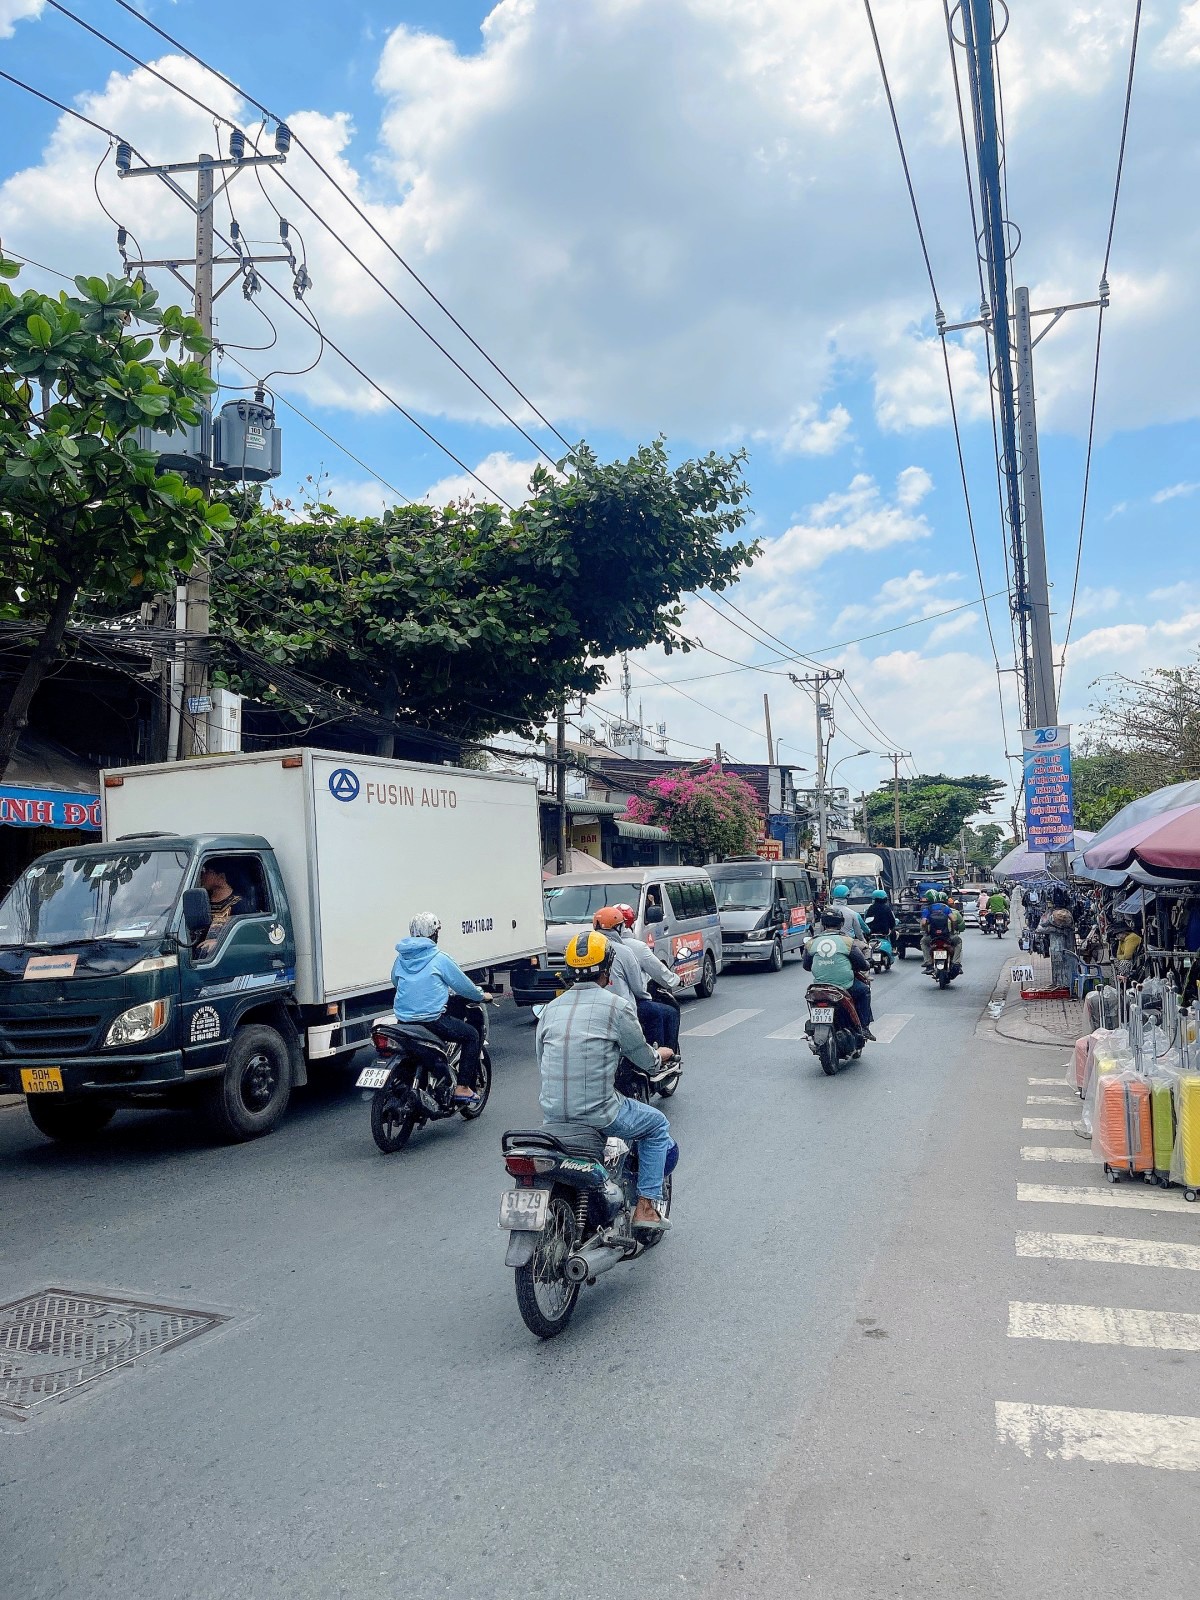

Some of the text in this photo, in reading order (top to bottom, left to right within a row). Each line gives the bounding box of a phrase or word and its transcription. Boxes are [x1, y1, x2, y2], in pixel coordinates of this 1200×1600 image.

[366, 782, 457, 809] FUSIN AUTO
[31, 1069, 50, 1080] 50H
[27, 1080, 60, 1092] 110.09
